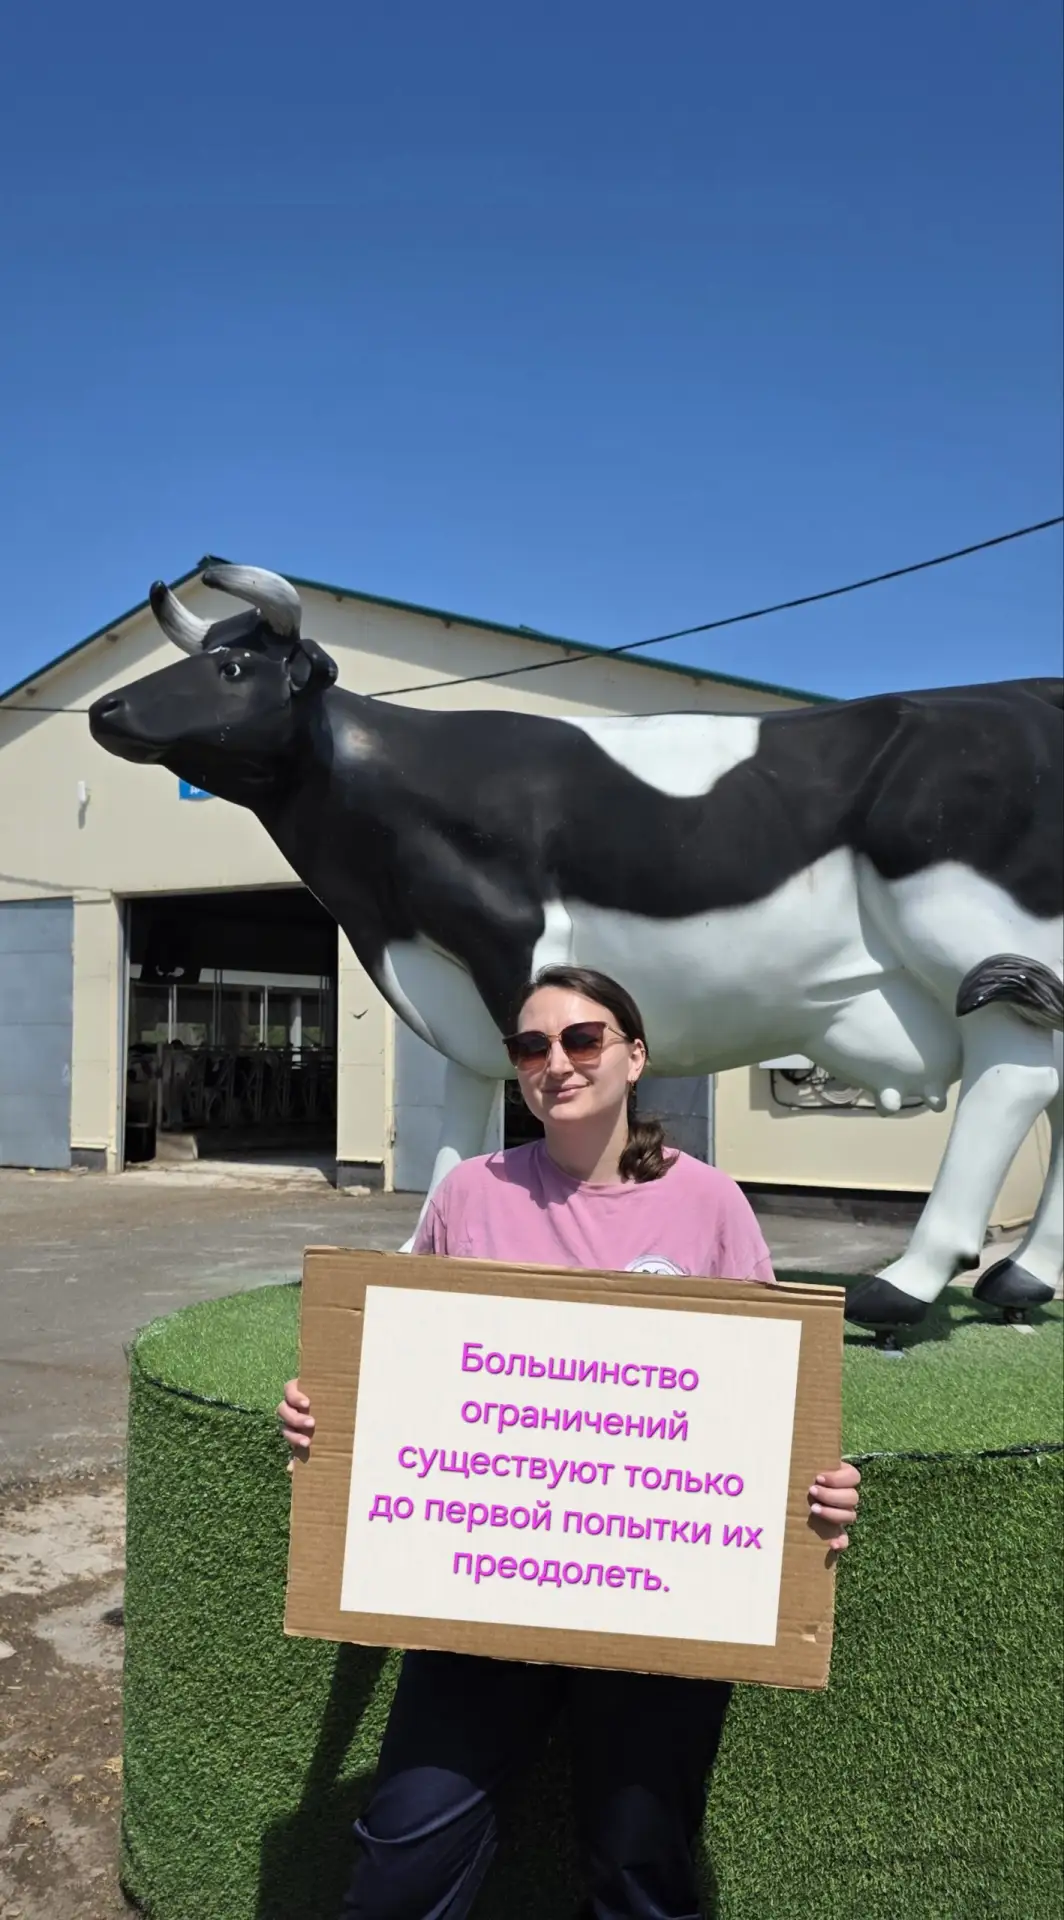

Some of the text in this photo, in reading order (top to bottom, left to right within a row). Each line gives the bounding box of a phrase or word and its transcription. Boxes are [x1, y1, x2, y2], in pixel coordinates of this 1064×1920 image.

[462, 1343, 699, 1391] Большинство
[461, 1401, 688, 1440] ограничений
[398, 1446, 744, 1496] существуют только
[368, 1495, 763, 1549] до первой попытки их
[453, 1552, 669, 1592] преодолеть.
